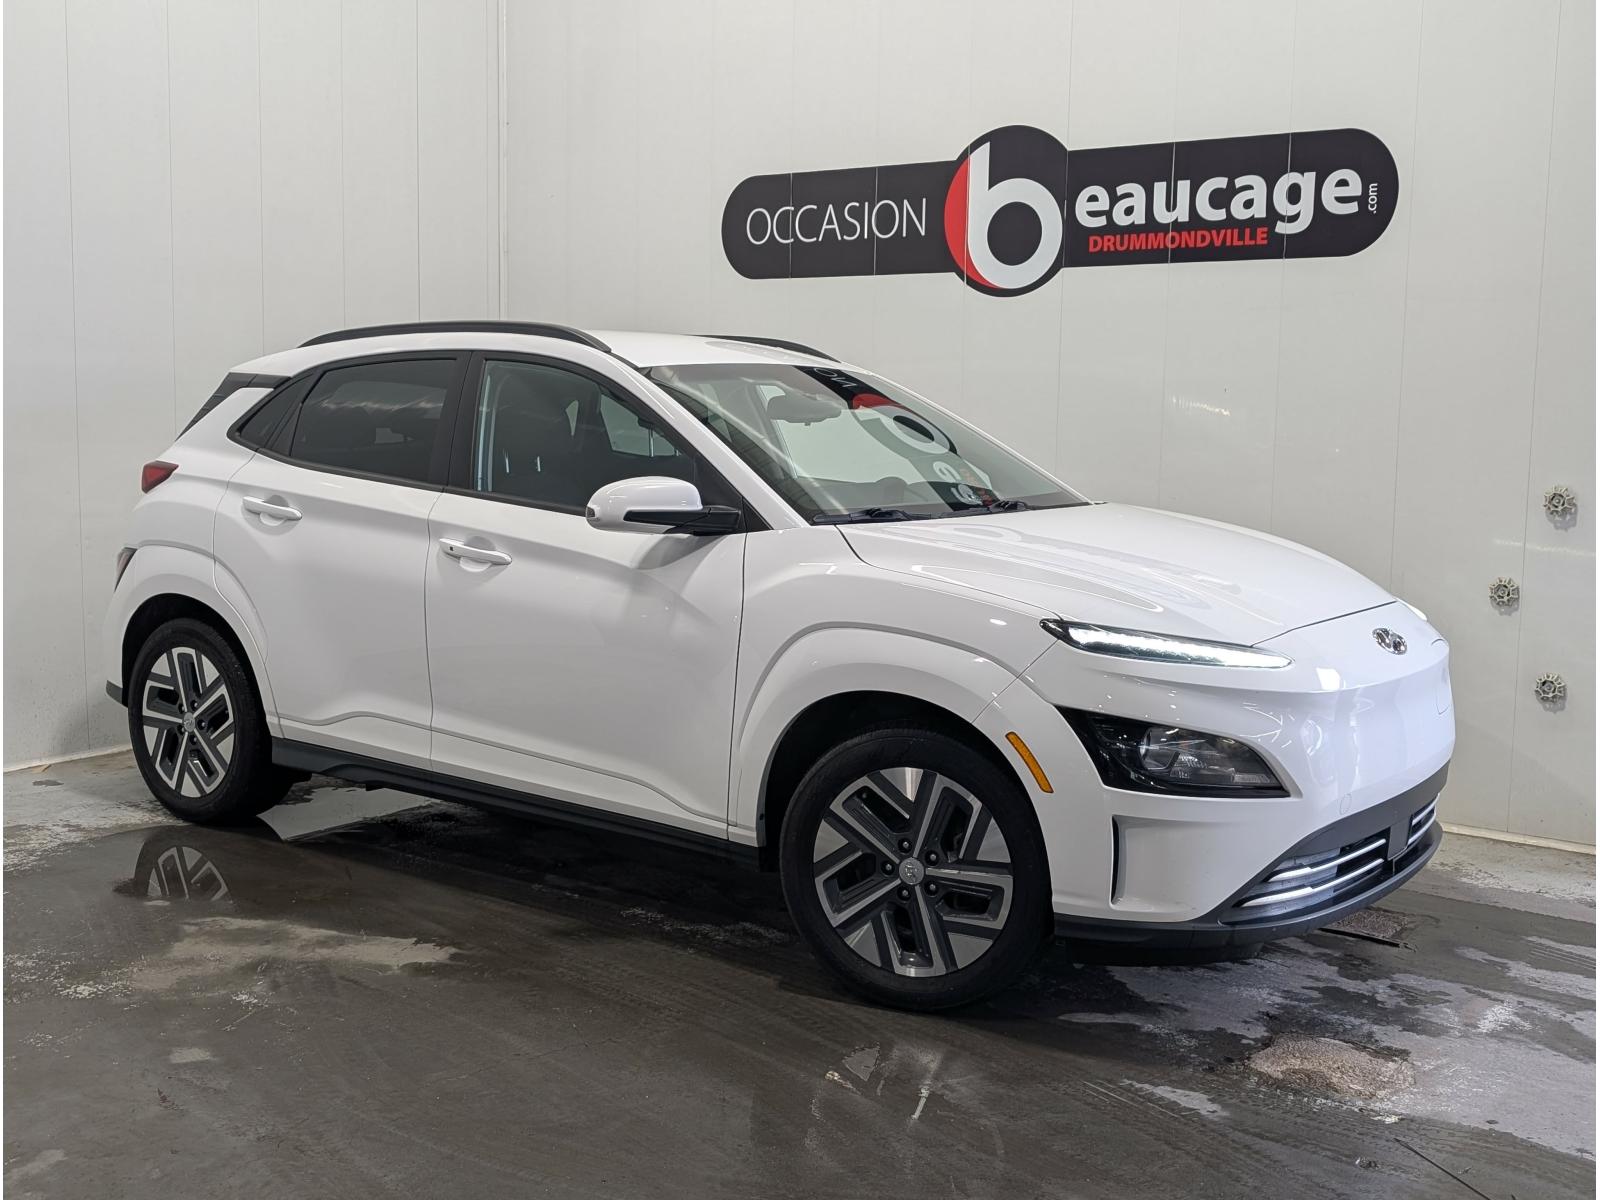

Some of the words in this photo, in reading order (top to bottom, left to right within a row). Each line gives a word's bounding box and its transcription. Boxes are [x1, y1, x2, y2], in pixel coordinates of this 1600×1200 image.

[1368, 183, 1378, 215] .com
[746, 198, 927, 245] OCCASION
[1088, 226, 1269, 253] DRUMMONDVILLE
